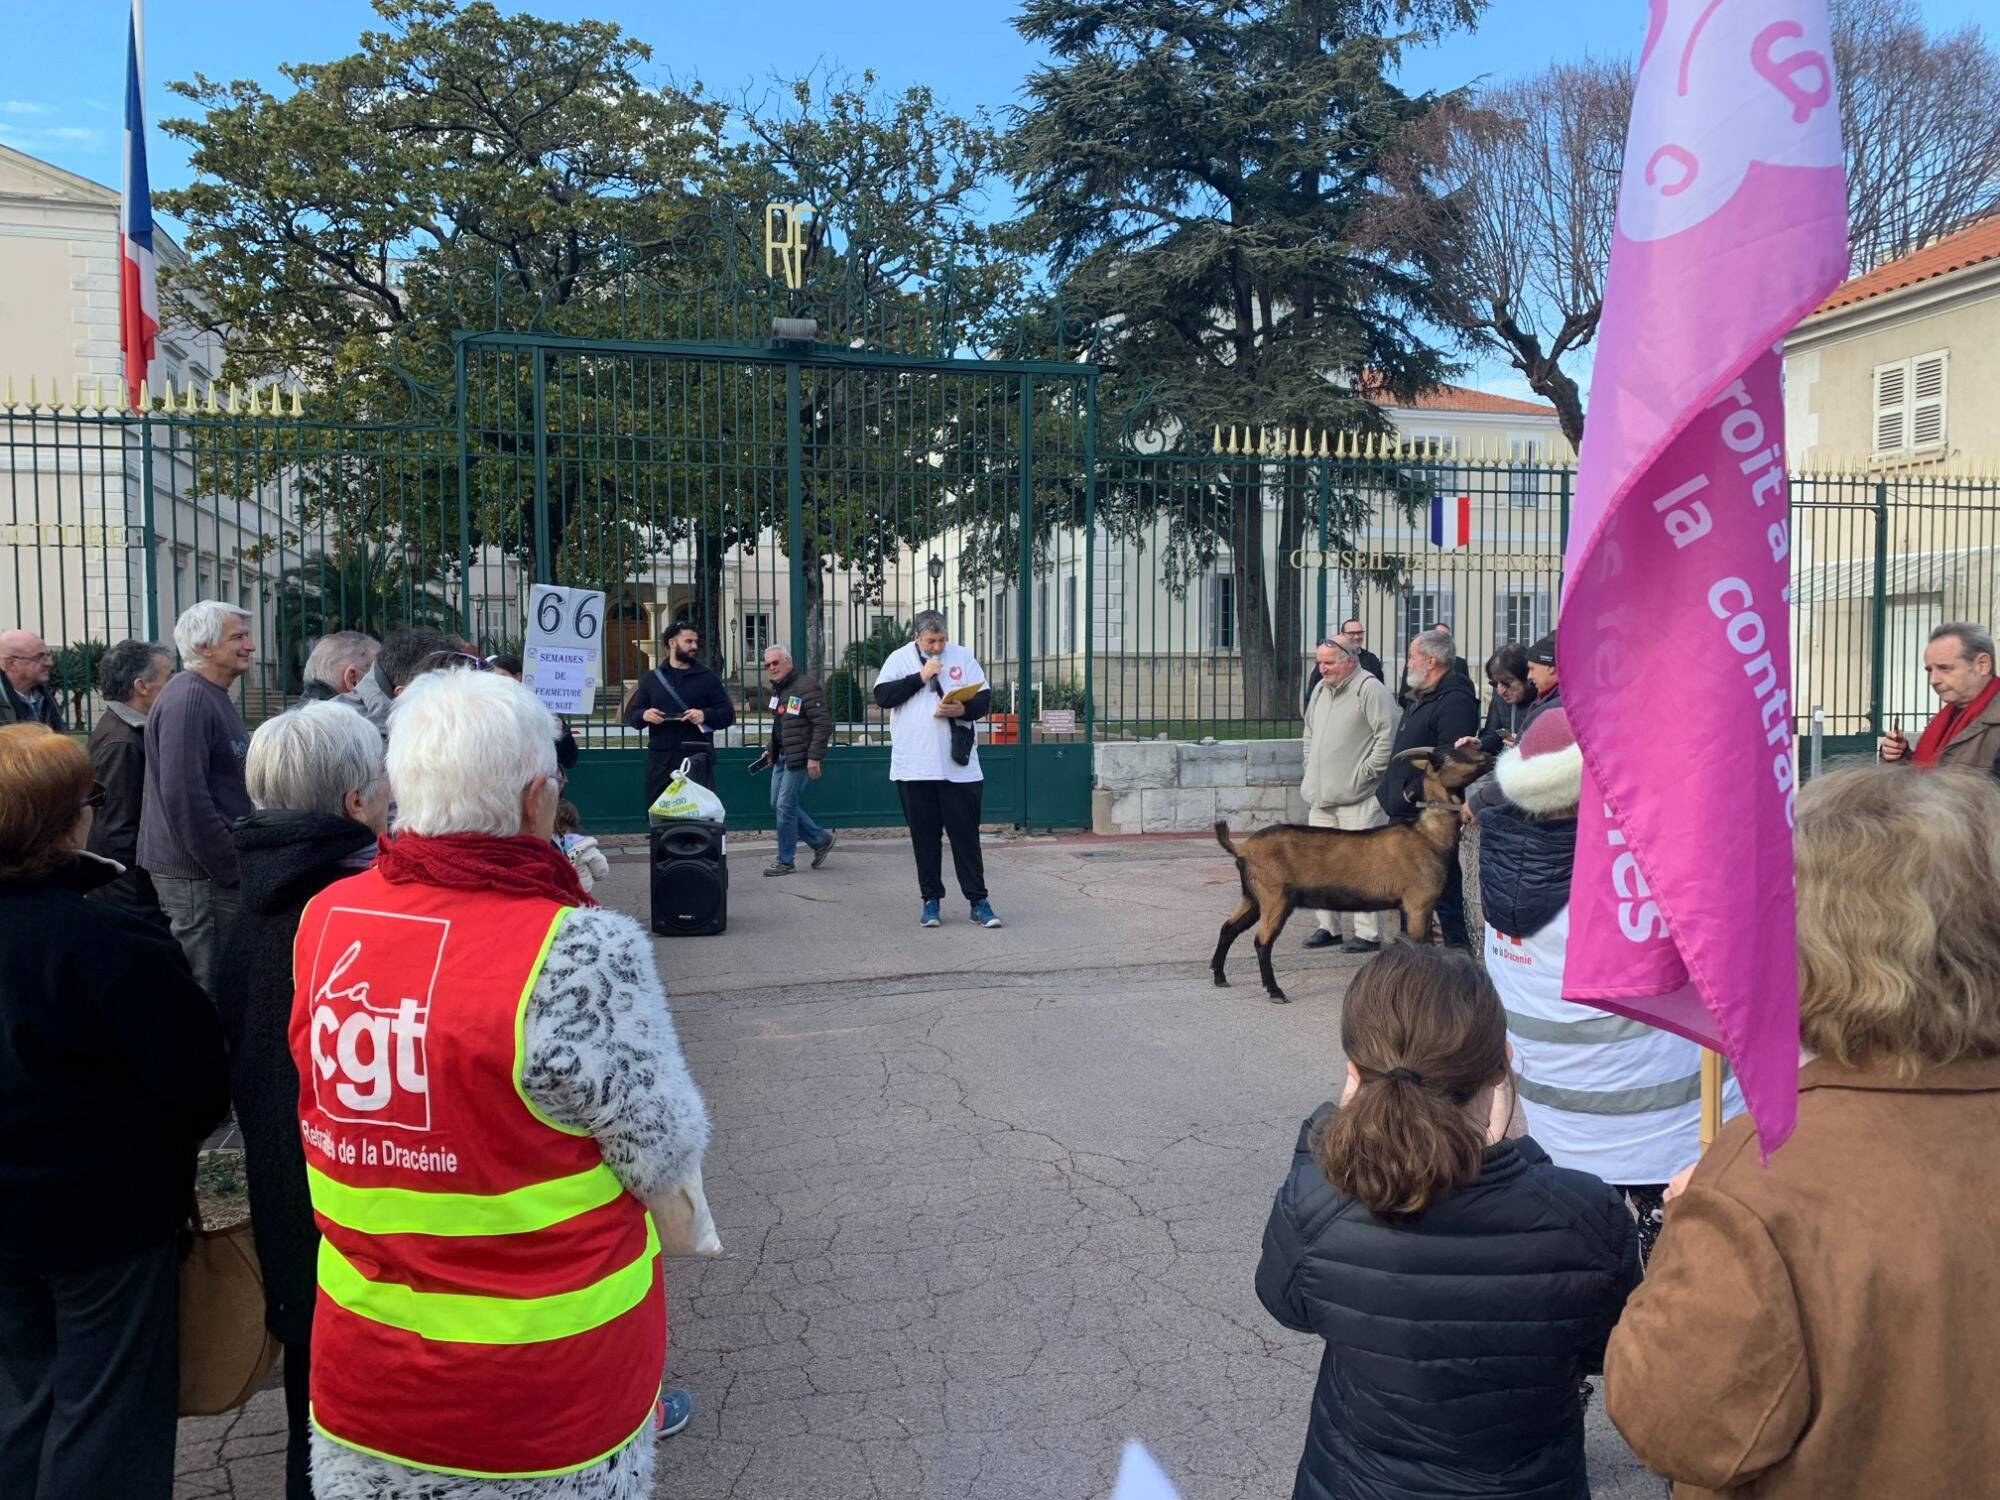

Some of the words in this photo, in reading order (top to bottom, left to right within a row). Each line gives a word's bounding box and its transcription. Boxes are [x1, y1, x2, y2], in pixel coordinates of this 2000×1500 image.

[766, 203, 817, 289] RF
[1707, 378, 1783, 507] roit
[1653, 474, 1713, 549] la
[1290, 549, 1391, 570] CONSEIL
[540, 653, 584, 664] SEMAINES
[554, 671, 566, 680] DE
[535, 687, 582, 697] FERMETURE
[554, 701, 573, 711] NUIT
[311, 999, 427, 1111] cgt
[338, 1137, 356, 1165] de
[362, 1138, 377, 1166] la
[382, 1140, 458, 1173] Dracénie
